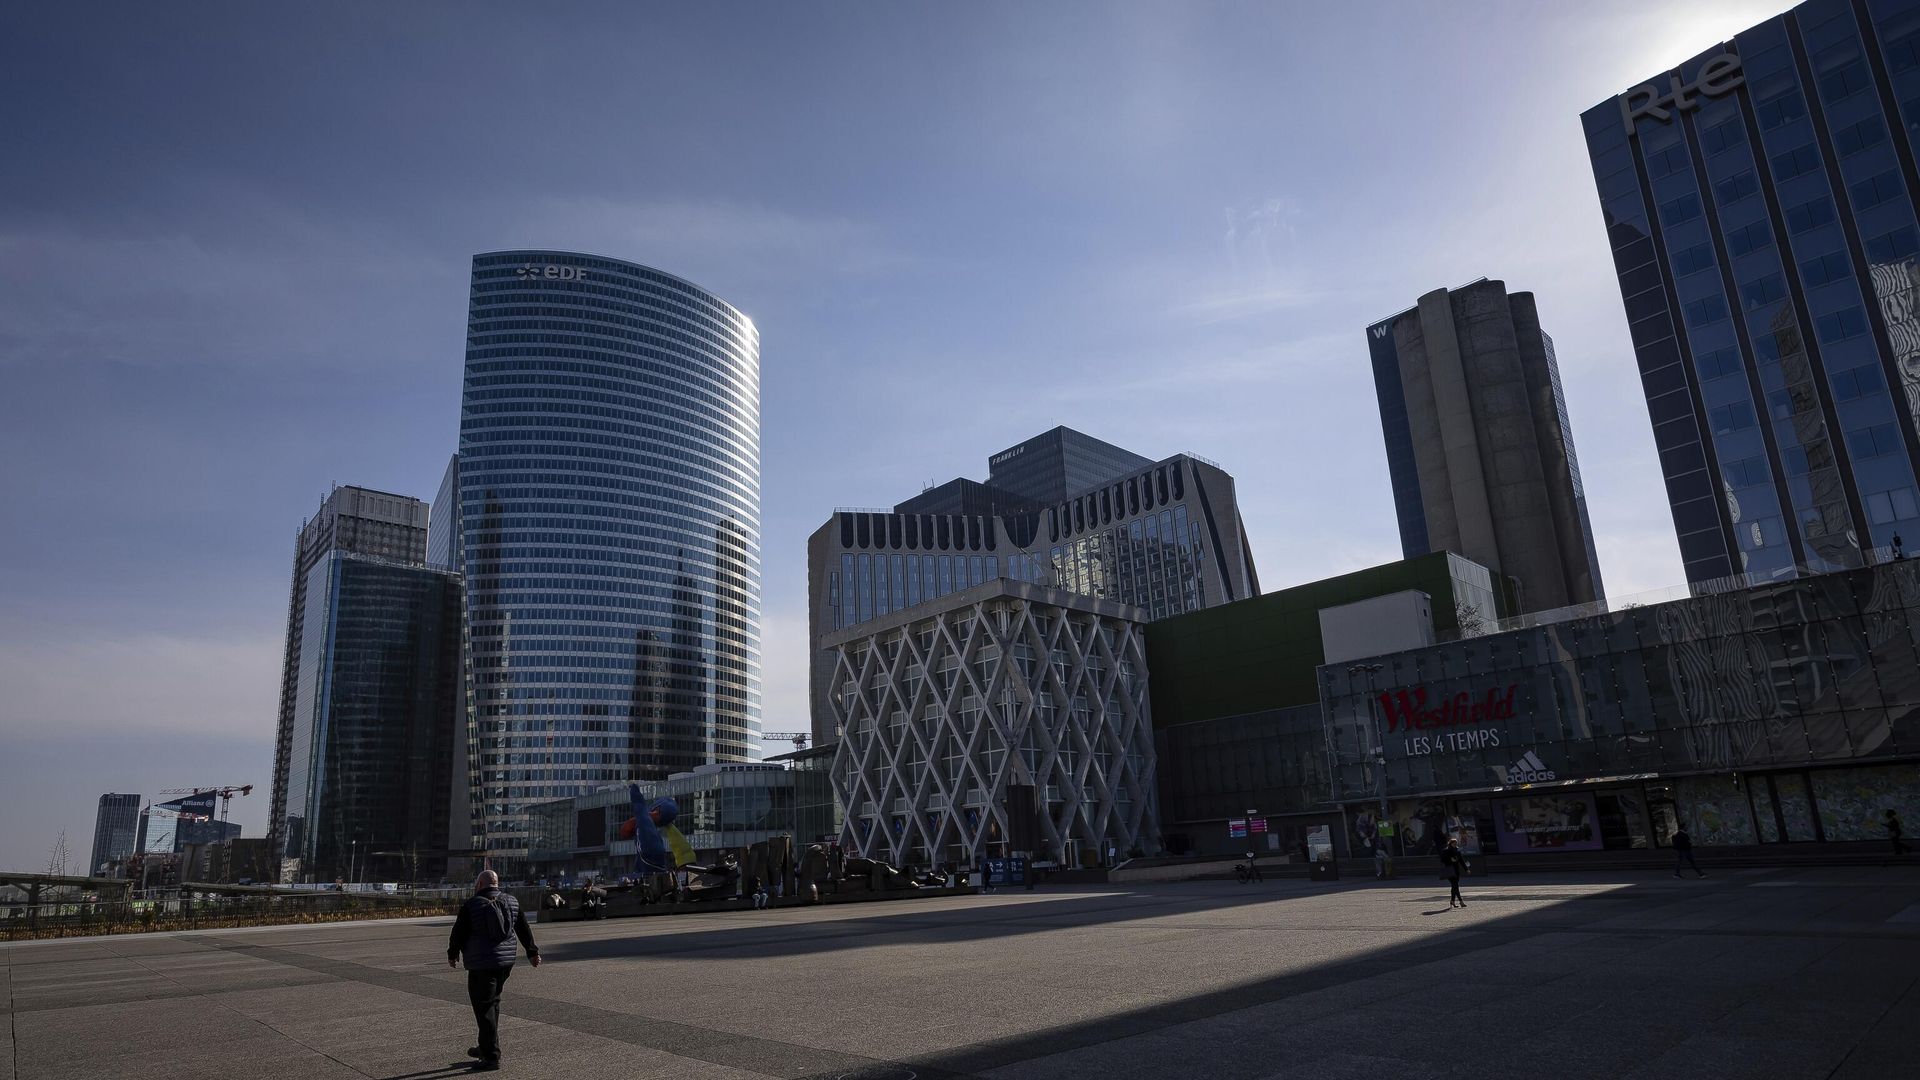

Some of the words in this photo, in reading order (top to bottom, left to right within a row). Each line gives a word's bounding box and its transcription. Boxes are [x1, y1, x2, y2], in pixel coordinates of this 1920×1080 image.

[1618, 53, 1744, 135] Rte
[1373, 324, 1387, 339] W
[992, 446, 1025, 465] FRANKLIN
[1377, 683, 1518, 733] Westfield
[1405, 736, 1432, 756] LES
[1435, 735, 1445, 753] 4
[1446, 728, 1500, 752] TEMPS
[1505, 769, 1556, 784] adidas
